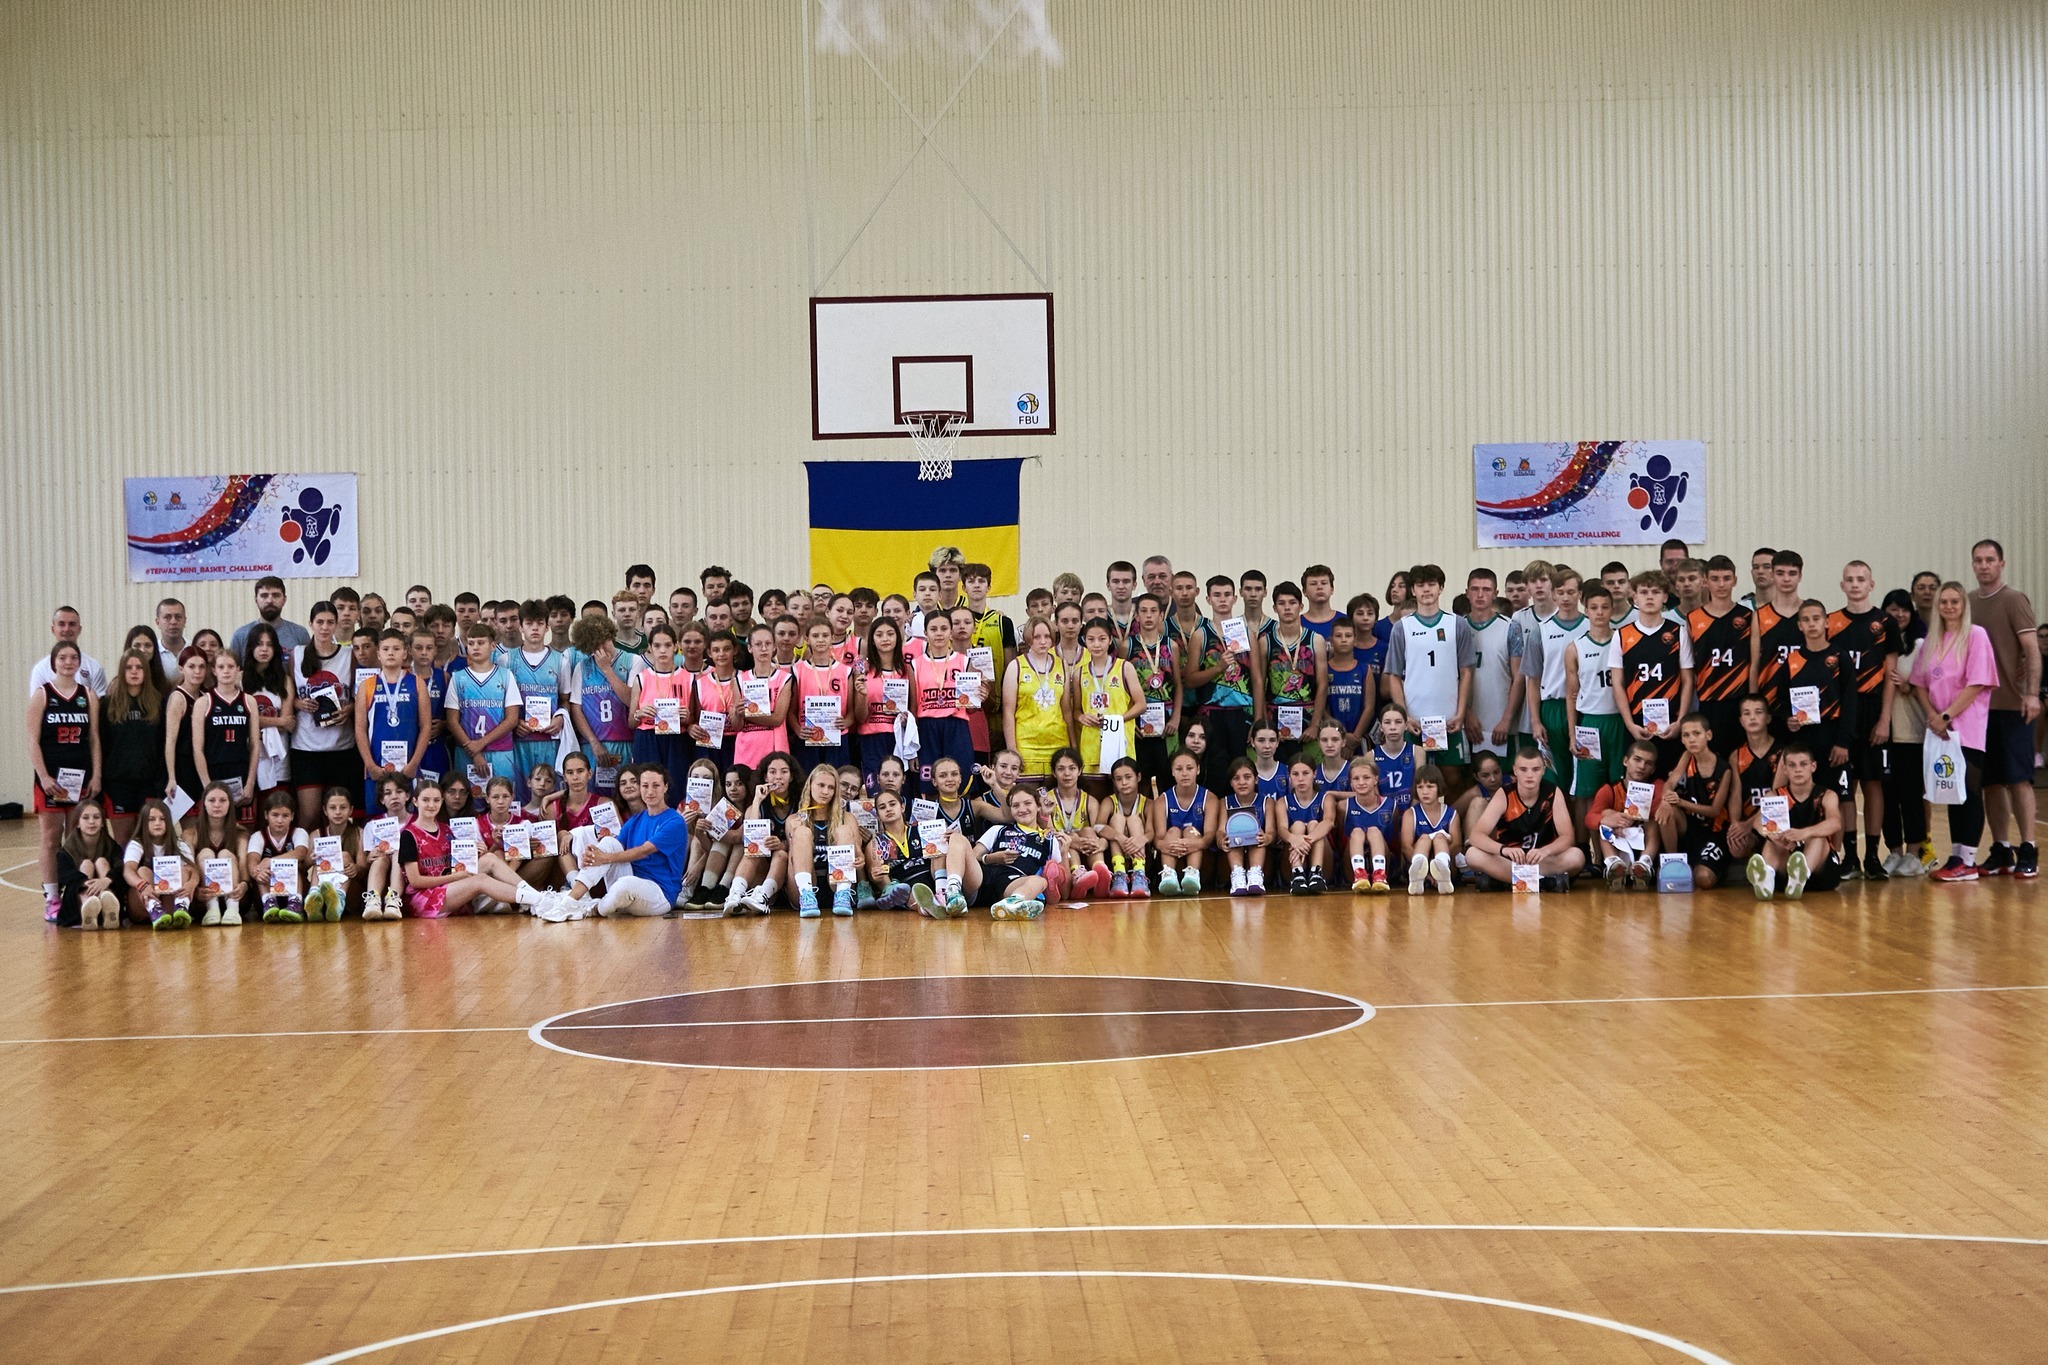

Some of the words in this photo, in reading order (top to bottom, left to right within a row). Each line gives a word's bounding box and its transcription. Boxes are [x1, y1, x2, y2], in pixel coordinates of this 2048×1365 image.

[1018, 415, 1039, 425] FBU
[1427, 651, 1436, 667] 1
[1711, 648, 1733, 667] 24
[1596, 669, 1613, 689] 18
[1638, 663, 1663, 682] 34
[831, 678, 841, 692] 6
[600, 699, 613, 723] 8
[212, 715, 247, 726] SATANIV
[476, 715, 487, 738] 4
[1102, 718, 1119, 732] BU
[57, 725, 82, 744] 22
[224, 729, 236, 743] 11
[1455, 743, 1464, 760] 1
[865, 772, 876, 788] 4
[920, 765, 934, 782] 8
[1387, 770, 1403, 789] 12
[1838, 769, 1849, 790] 4
[1935, 780, 1954, 790] FBU
[1700, 840, 1724, 862] 25
